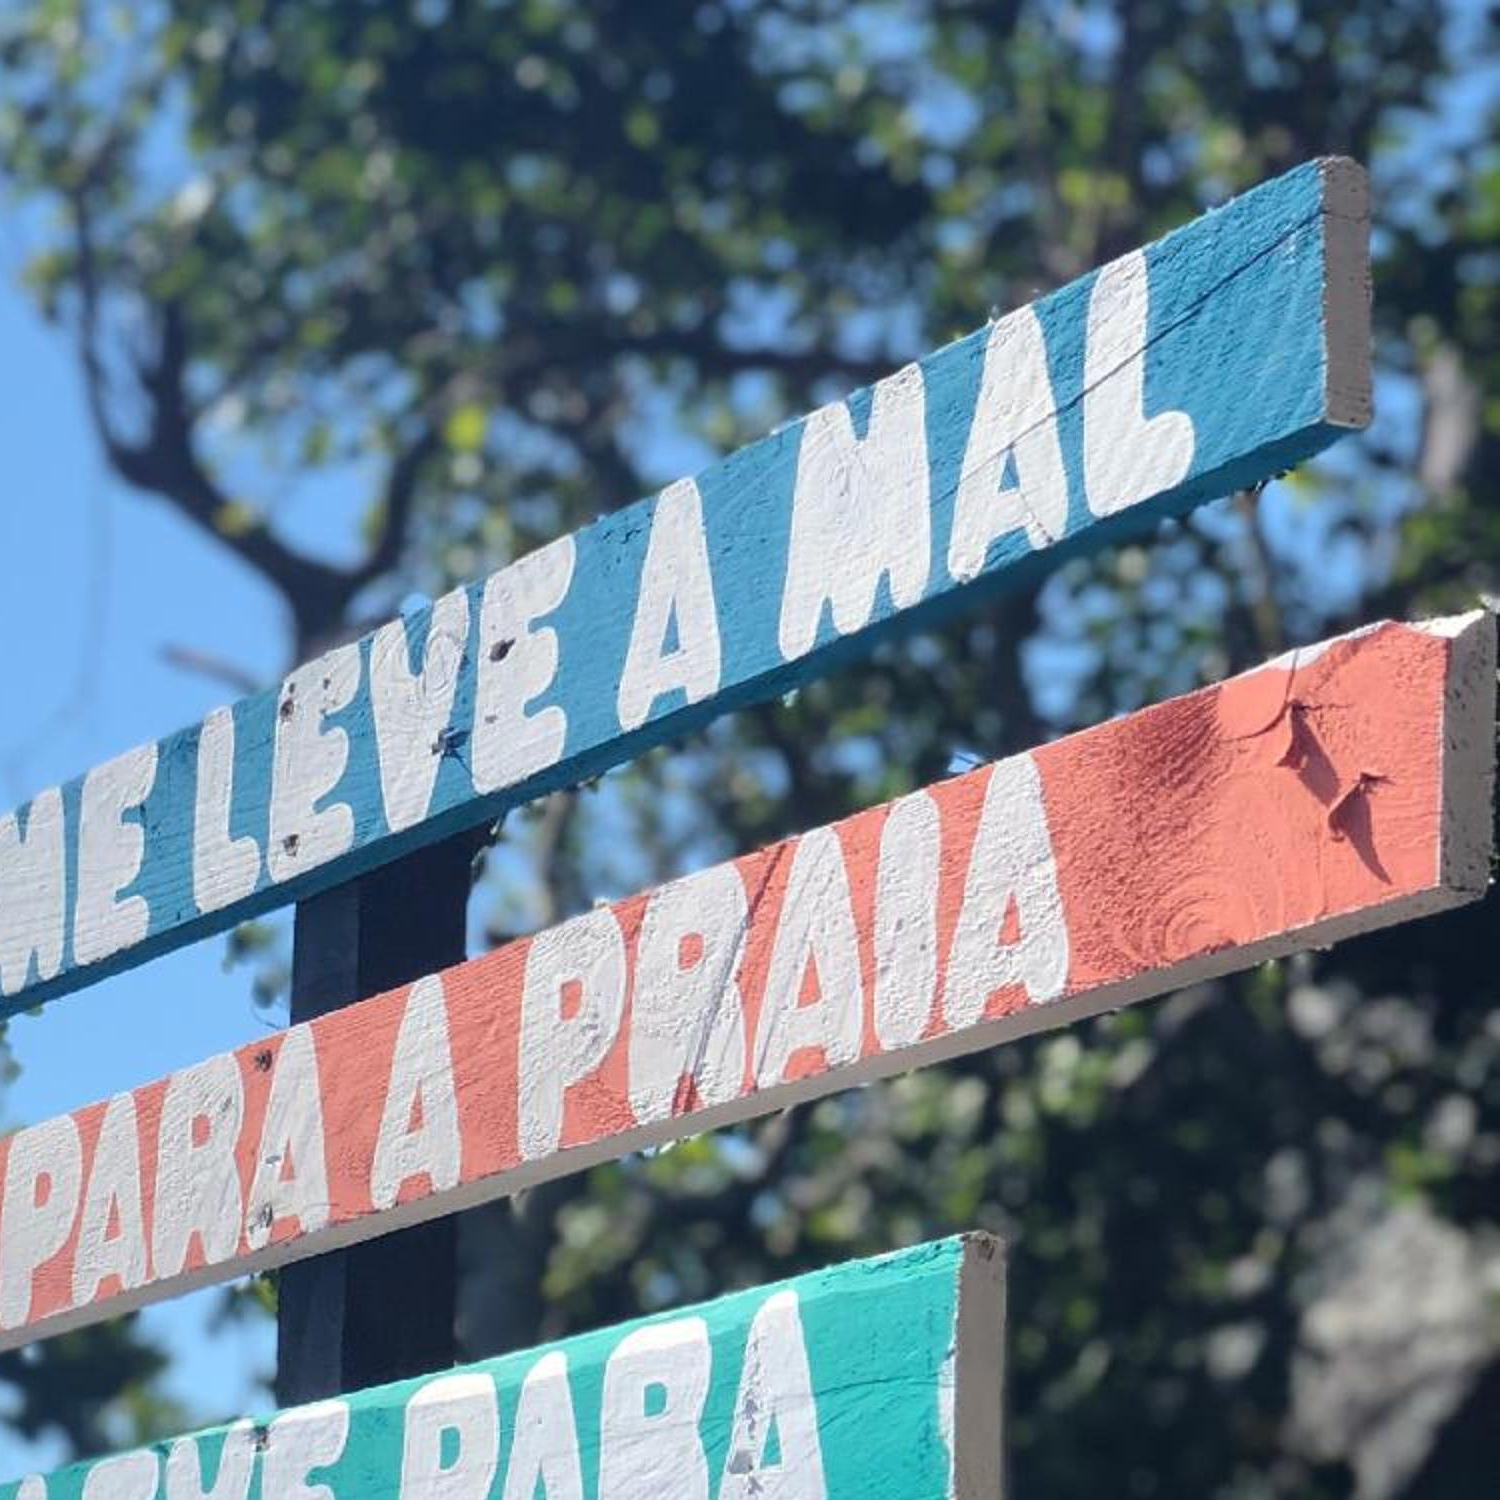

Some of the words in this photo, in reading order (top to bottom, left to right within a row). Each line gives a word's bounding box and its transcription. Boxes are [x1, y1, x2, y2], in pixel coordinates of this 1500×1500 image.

[194, 535, 576, 912] LEVE
[618, 477, 722, 731] A
[779, 248, 1195, 664] MAL
[371, 974, 463, 1209] A
[517, 752, 1071, 1162] PRAIA
